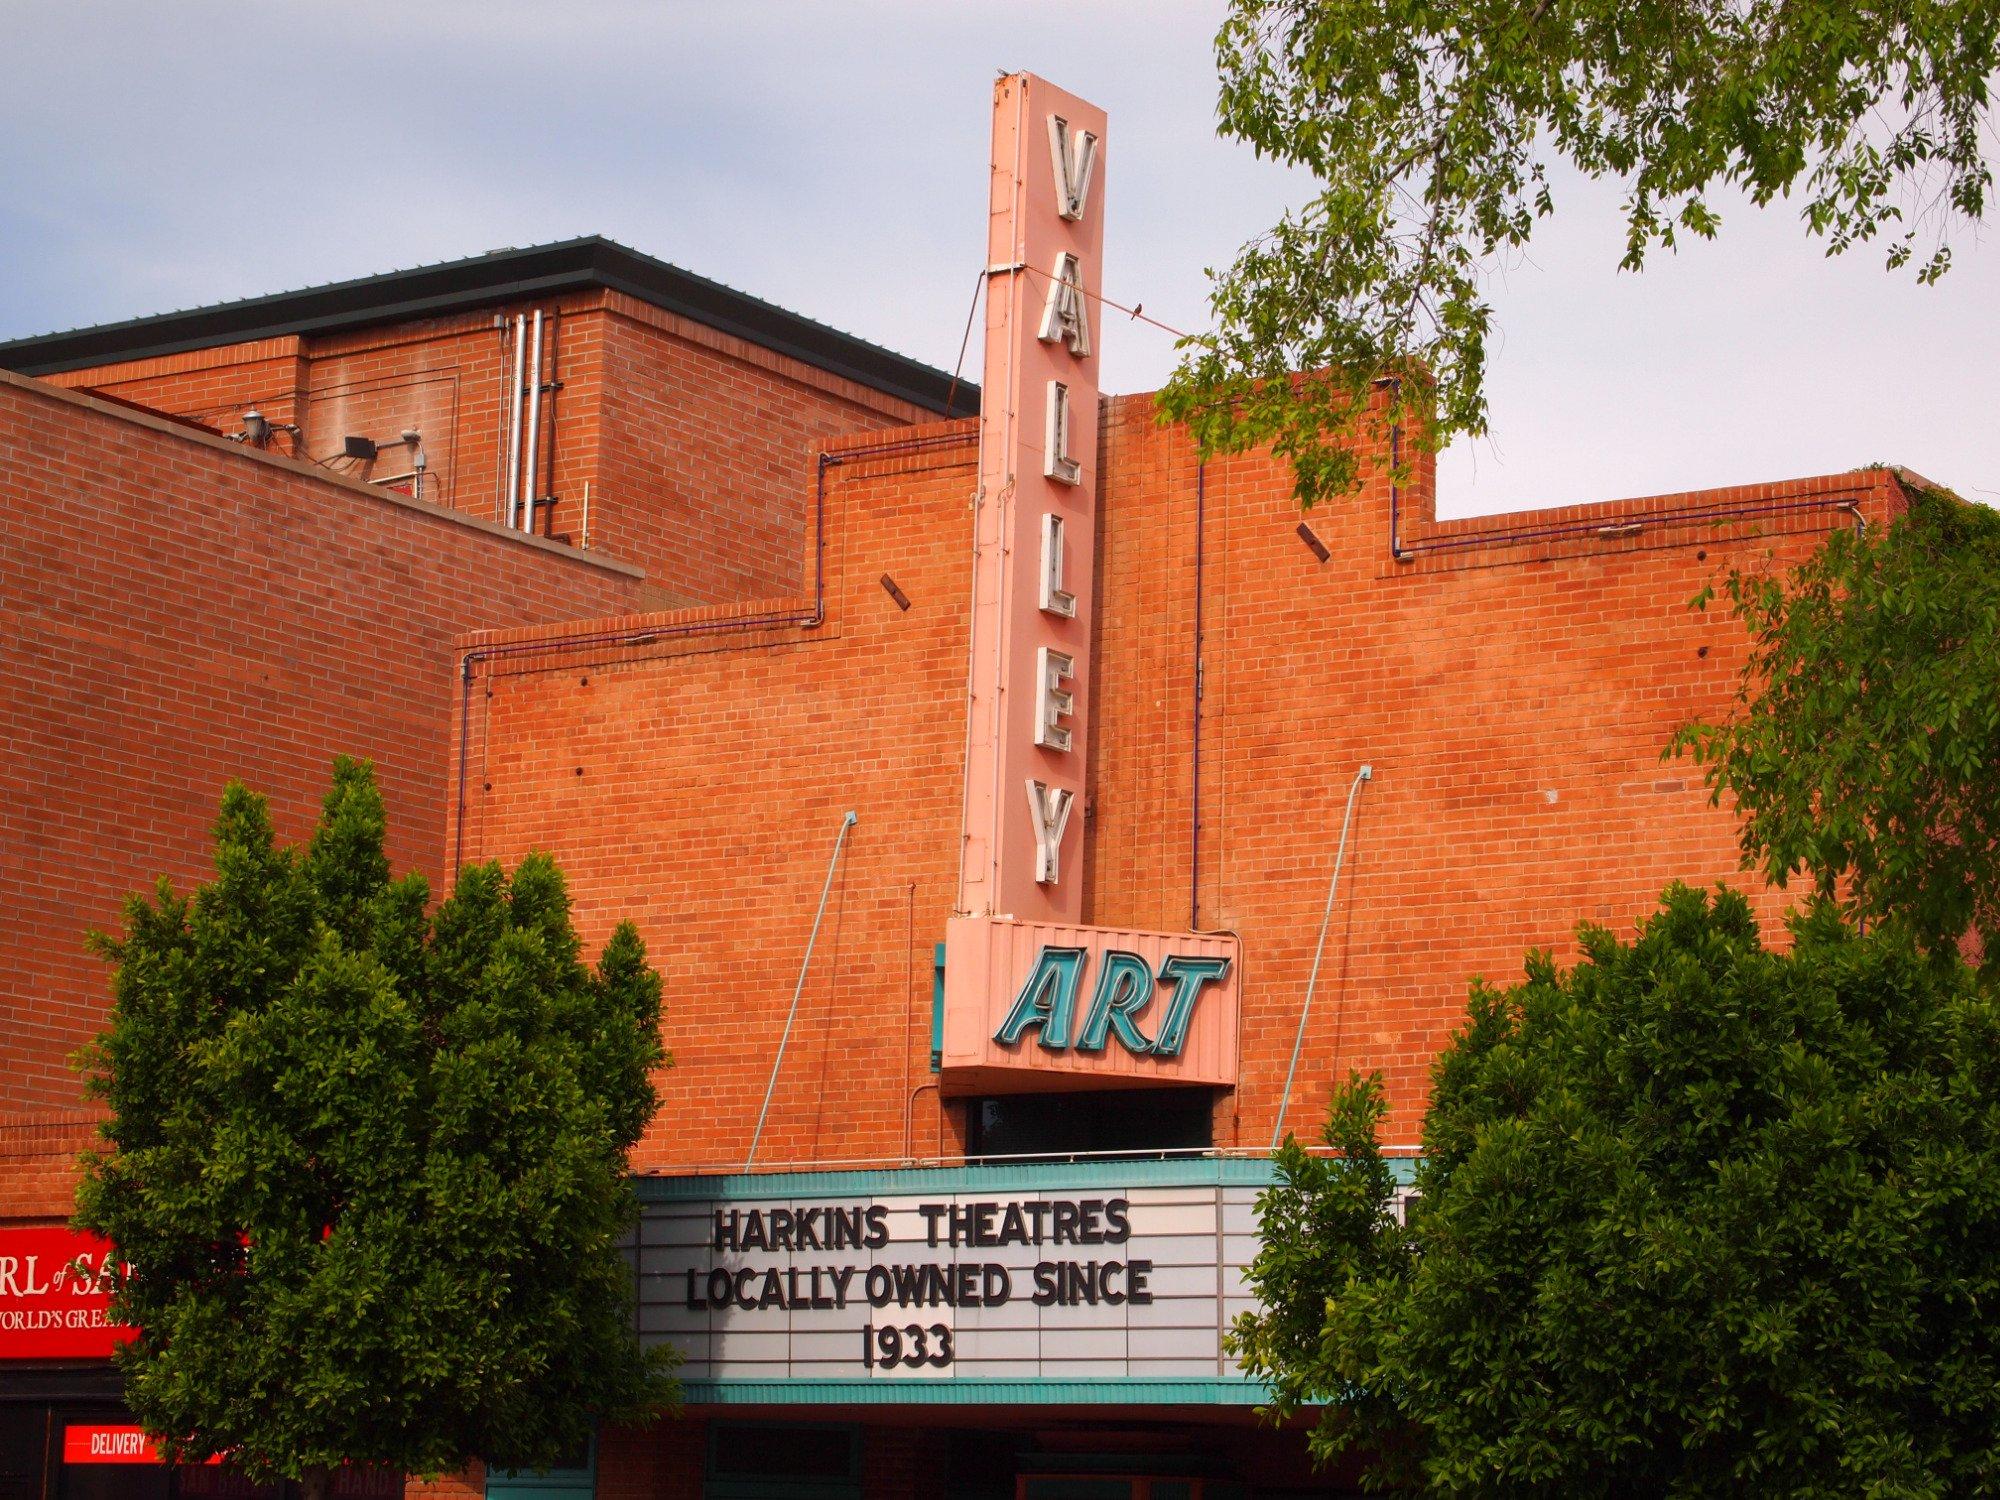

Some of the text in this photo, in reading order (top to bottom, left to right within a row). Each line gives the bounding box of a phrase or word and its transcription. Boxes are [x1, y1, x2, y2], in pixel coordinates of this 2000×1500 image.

[1024, 113, 1098, 885] VALLEY
[993, 945, 1231, 1057] ART
[715, 1198, 1131, 1251] HARKINS THEATRES
[53, 1262, 72, 1292] of
[687, 1260, 1152, 1310] LOCALLY OWNED SINCE
[0, 1310, 62, 1330] ORLD'S
[863, 1323, 954, 1369] 1933
[90, 1432, 146, 1455] DELIVERY
